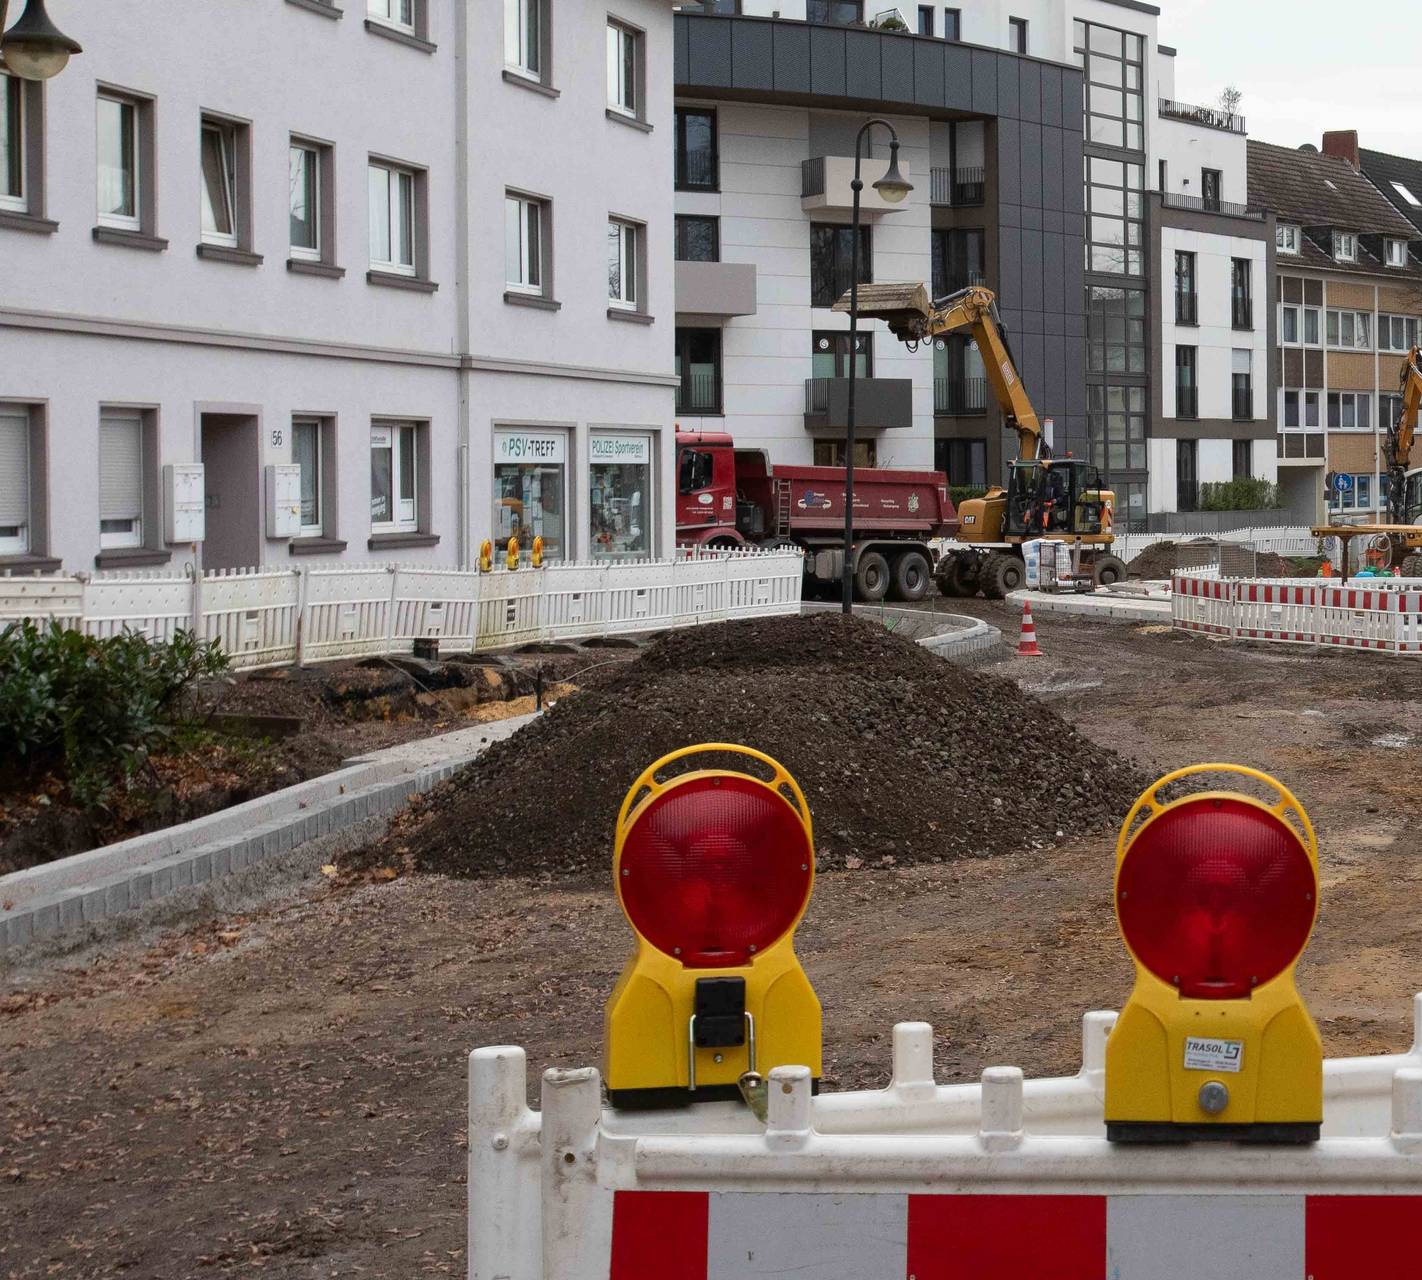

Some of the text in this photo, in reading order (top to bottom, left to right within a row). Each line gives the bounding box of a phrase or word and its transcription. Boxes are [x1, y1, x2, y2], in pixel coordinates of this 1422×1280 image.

[272, 430, 283, 446] 56
[592, 440, 613, 454] POLIZEI
[964, 516, 975, 524] CAT
[1187, 1041, 1224, 1054] TRASOL
